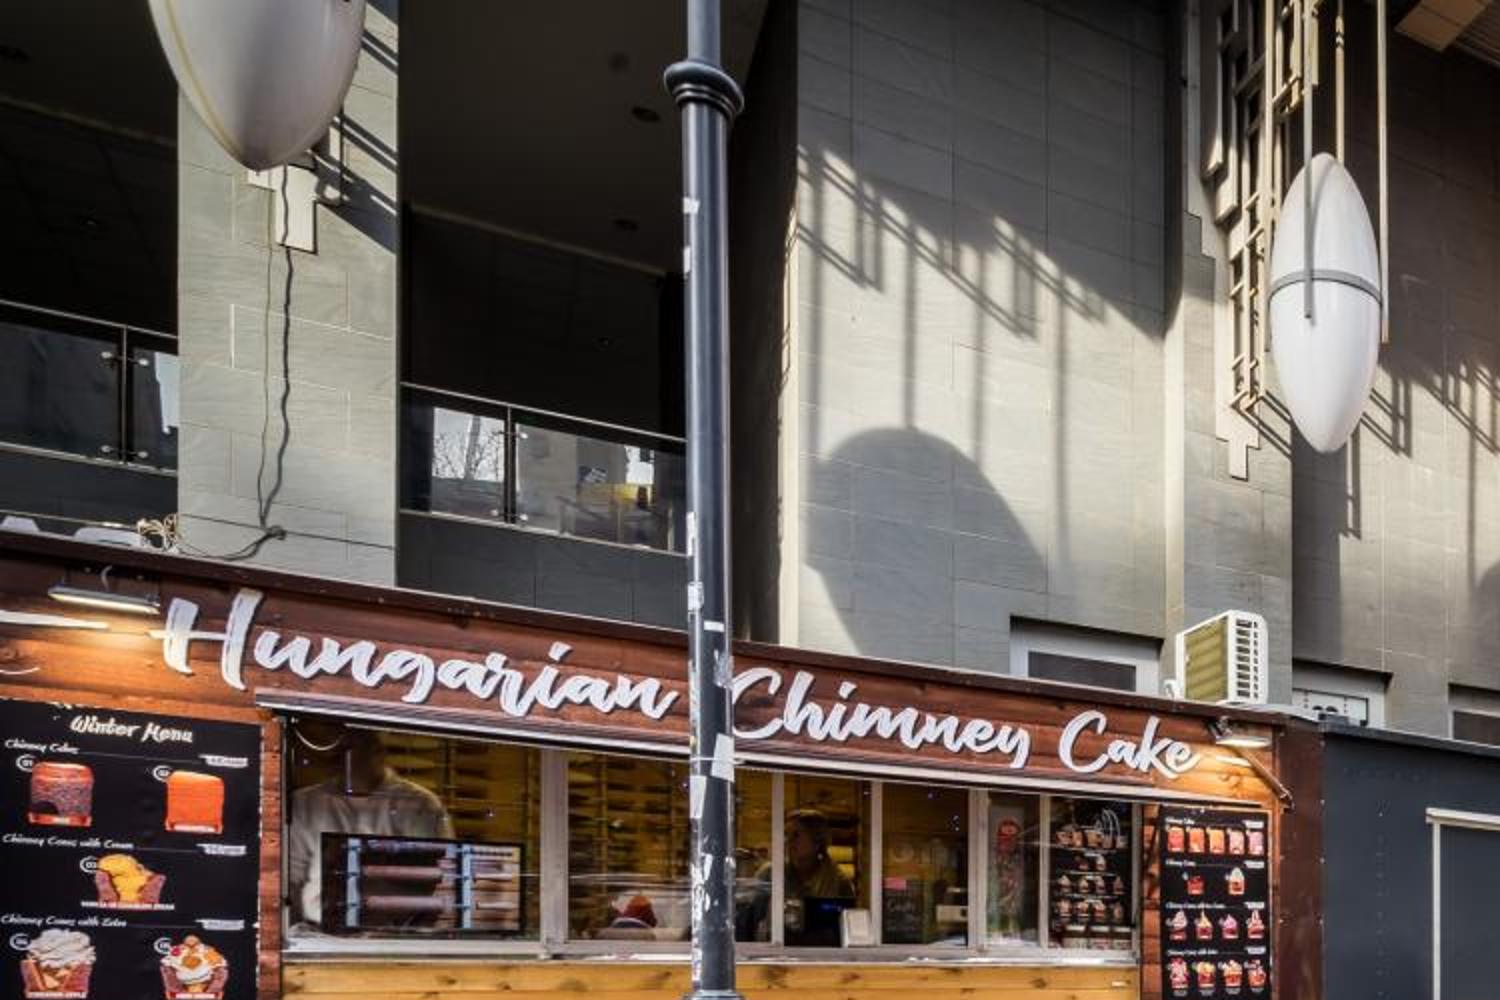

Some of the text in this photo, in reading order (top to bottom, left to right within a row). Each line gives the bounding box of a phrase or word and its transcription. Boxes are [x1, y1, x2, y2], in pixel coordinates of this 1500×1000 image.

[146, 587, 1202, 779] Hungarian Chimney Cake
[69, 714, 194, 744] Winter Menu
[4, 738, 47, 753] Chimney
[2, 832, 45, 848] Chimney
[79, 837, 101, 849] with
[0, 913, 43, 928] Chimney
